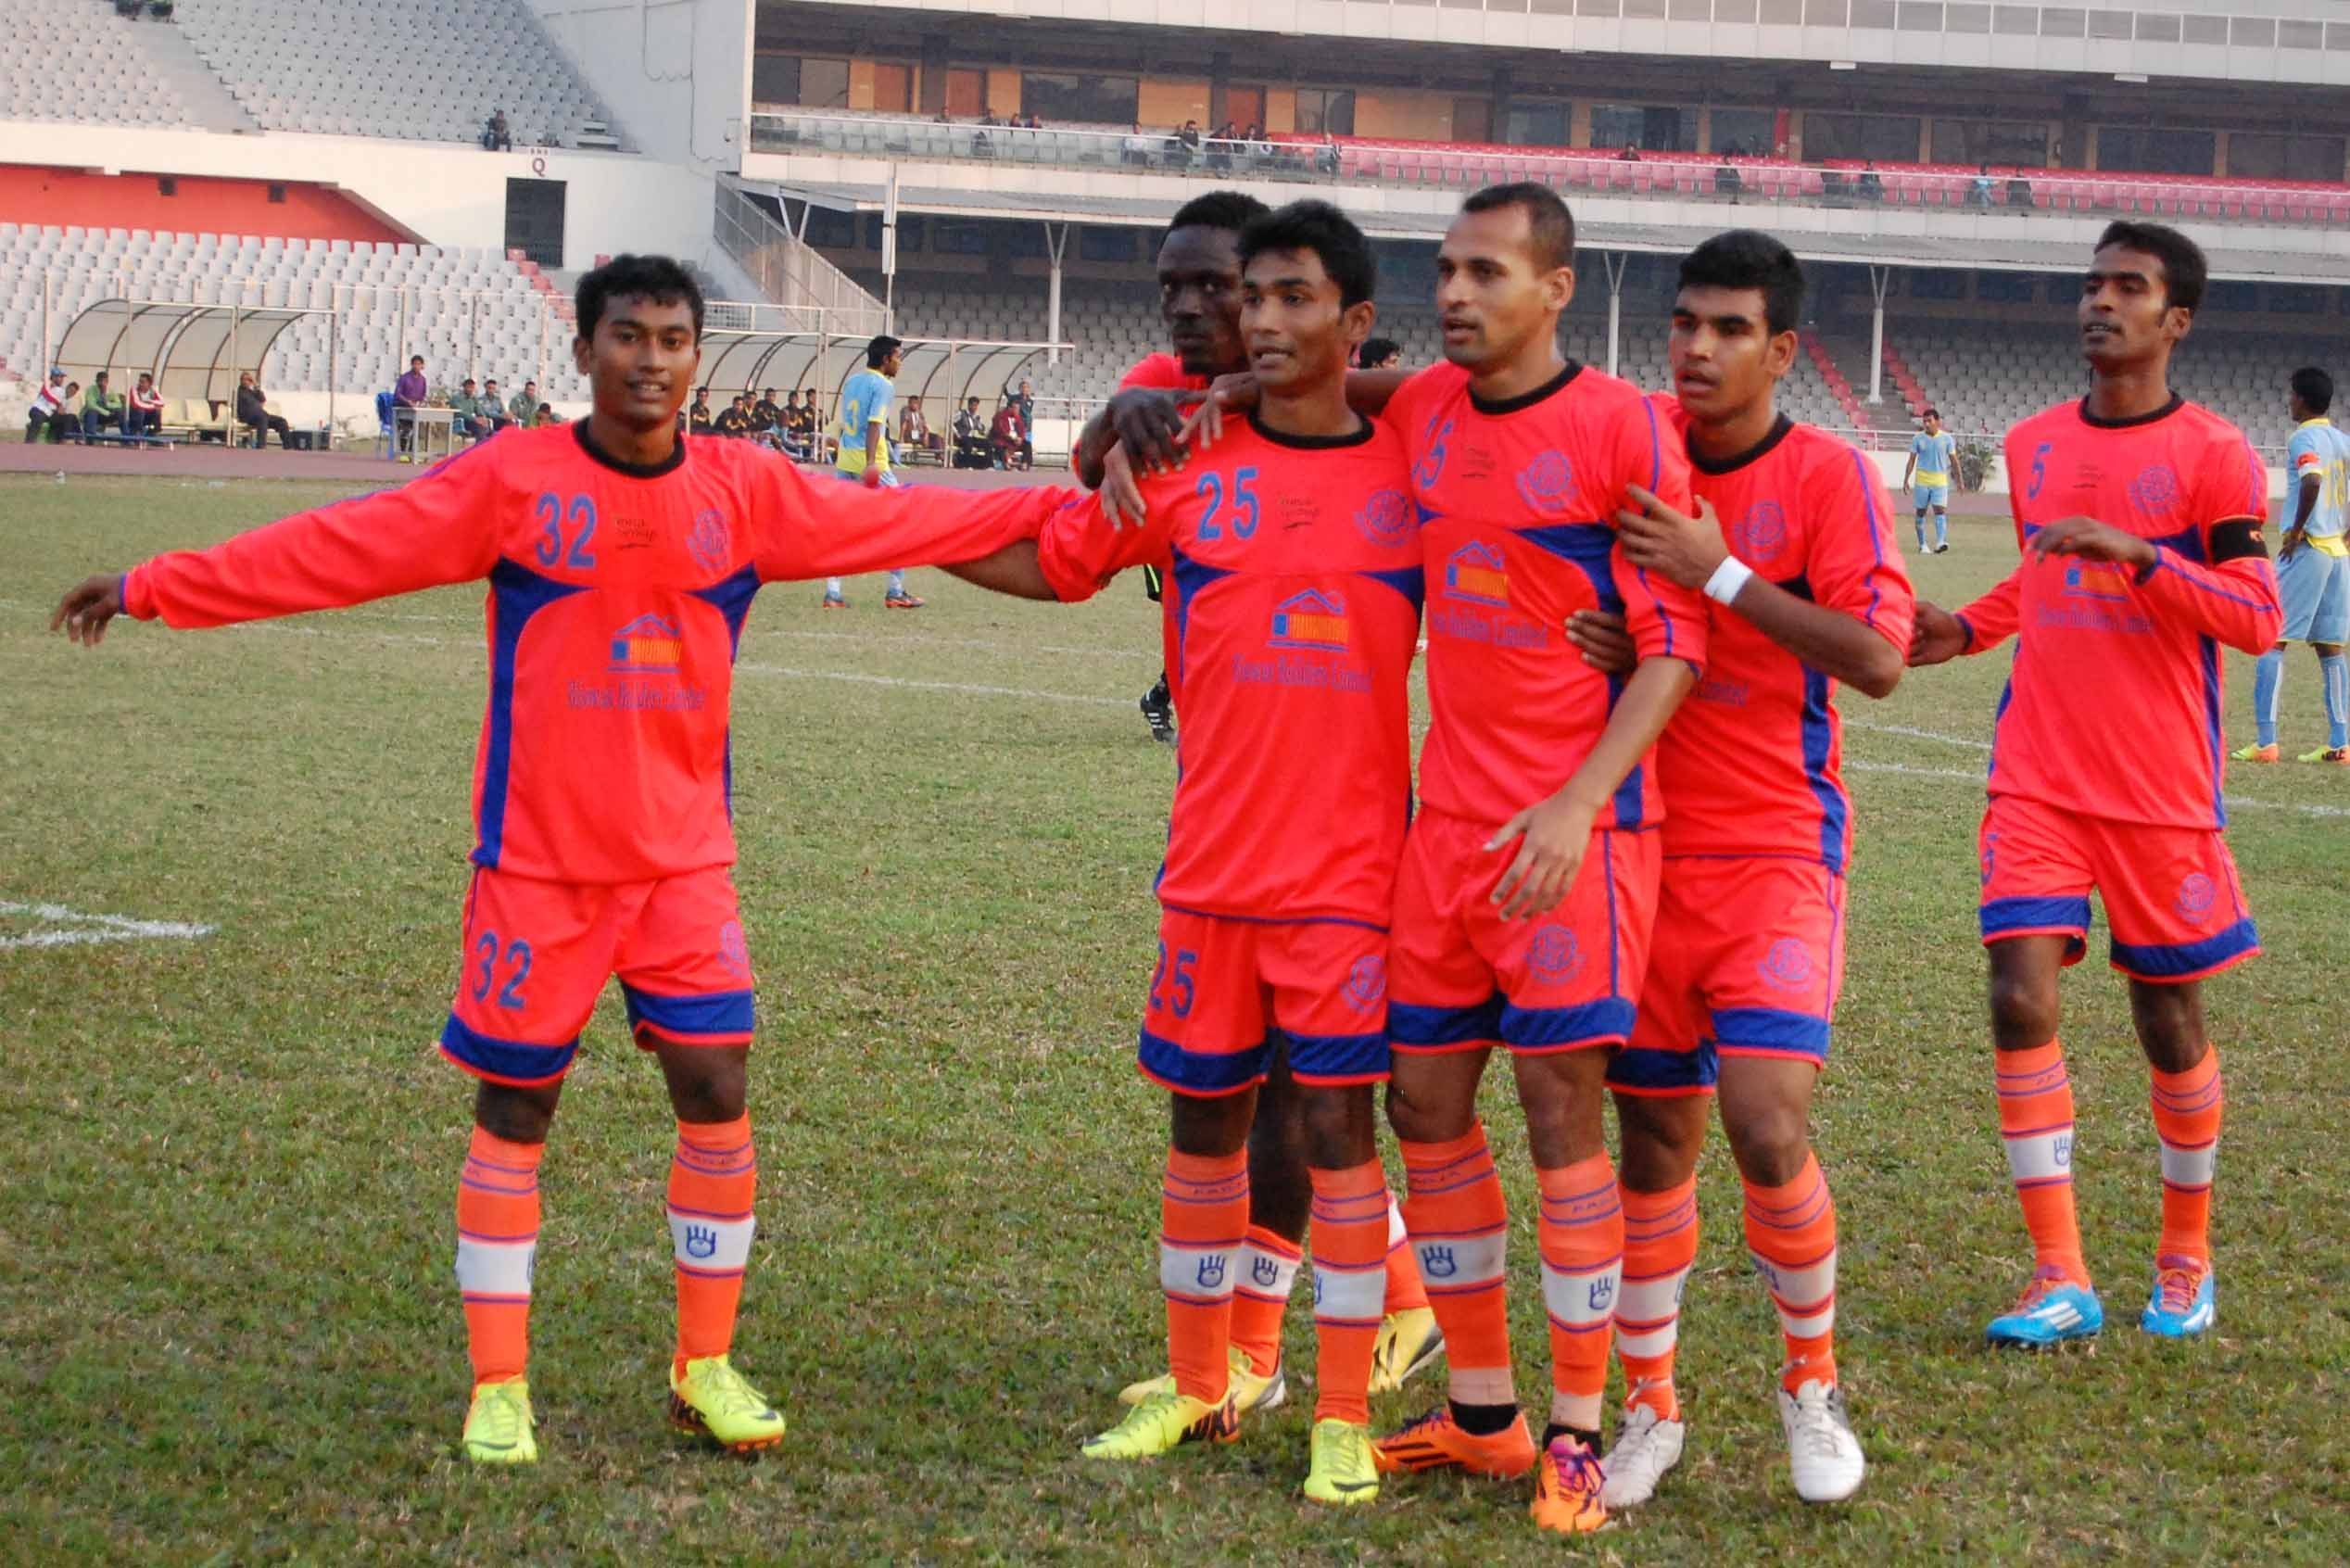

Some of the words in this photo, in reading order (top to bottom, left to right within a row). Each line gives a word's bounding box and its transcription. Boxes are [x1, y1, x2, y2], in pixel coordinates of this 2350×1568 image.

[532, 157, 545, 177] Q
[847, 399, 860, 436] 3
[1195, 466, 1259, 540] 25
[2028, 443, 2052, 499] 5
[535, 491, 596, 569] 32
[473, 930, 531, 1009] 32
[1150, 942, 1198, 1019] 25
